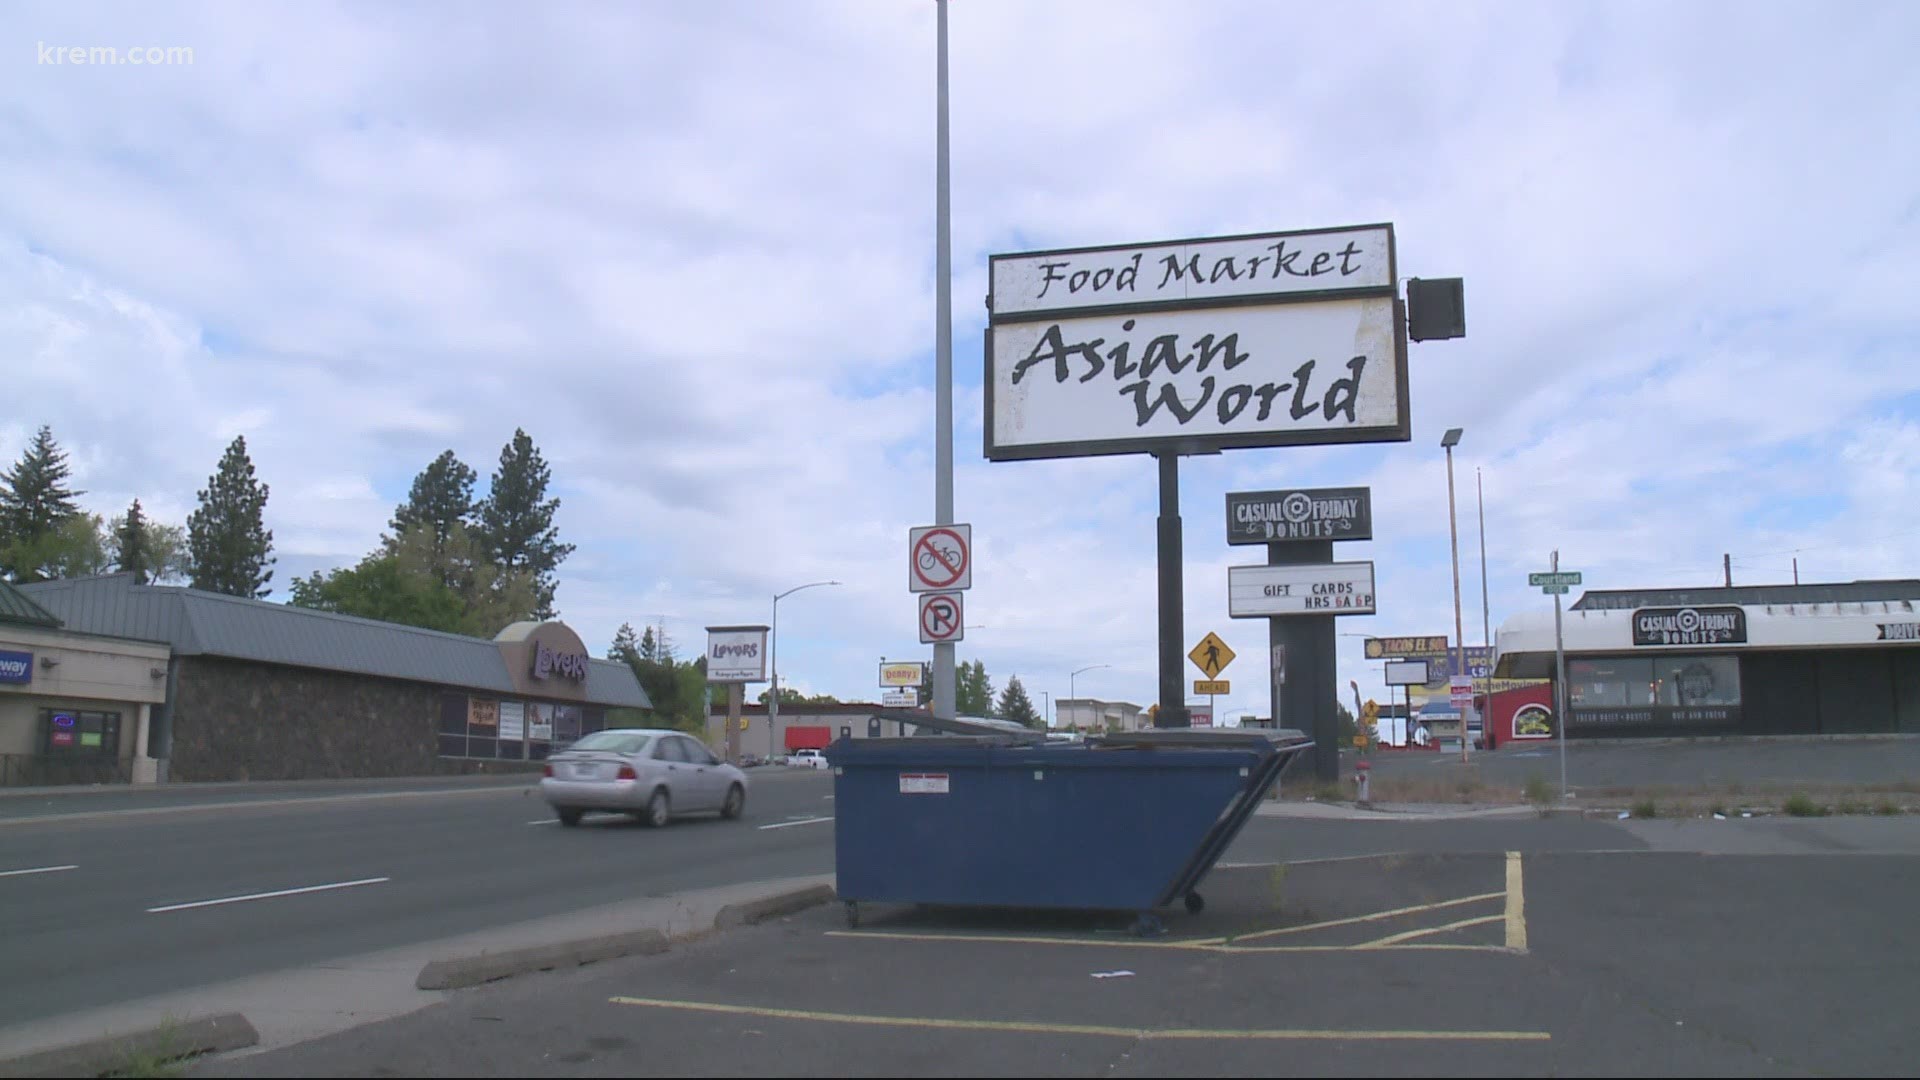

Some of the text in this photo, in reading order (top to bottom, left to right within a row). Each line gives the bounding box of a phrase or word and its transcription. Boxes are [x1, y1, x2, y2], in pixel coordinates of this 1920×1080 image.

[1037, 240, 1363, 298] Food Market
[1011, 319, 1250, 385] Asian
[1119, 356, 1367, 427] World
[1236, 499, 1358, 523] CASUAL FRIDAY
[1265, 519, 1333, 538] DONUTS
[1531, 574, 1580, 585] Courtland
[1263, 582, 1353, 597] GIFT CARDS
[1305, 596, 1330, 609] HRS
[1640, 614, 1737, 632] CASUAL FRIDAY
[1662, 630, 1717, 644] DONUTS
[1199, 682, 1225, 692] AHEAD
